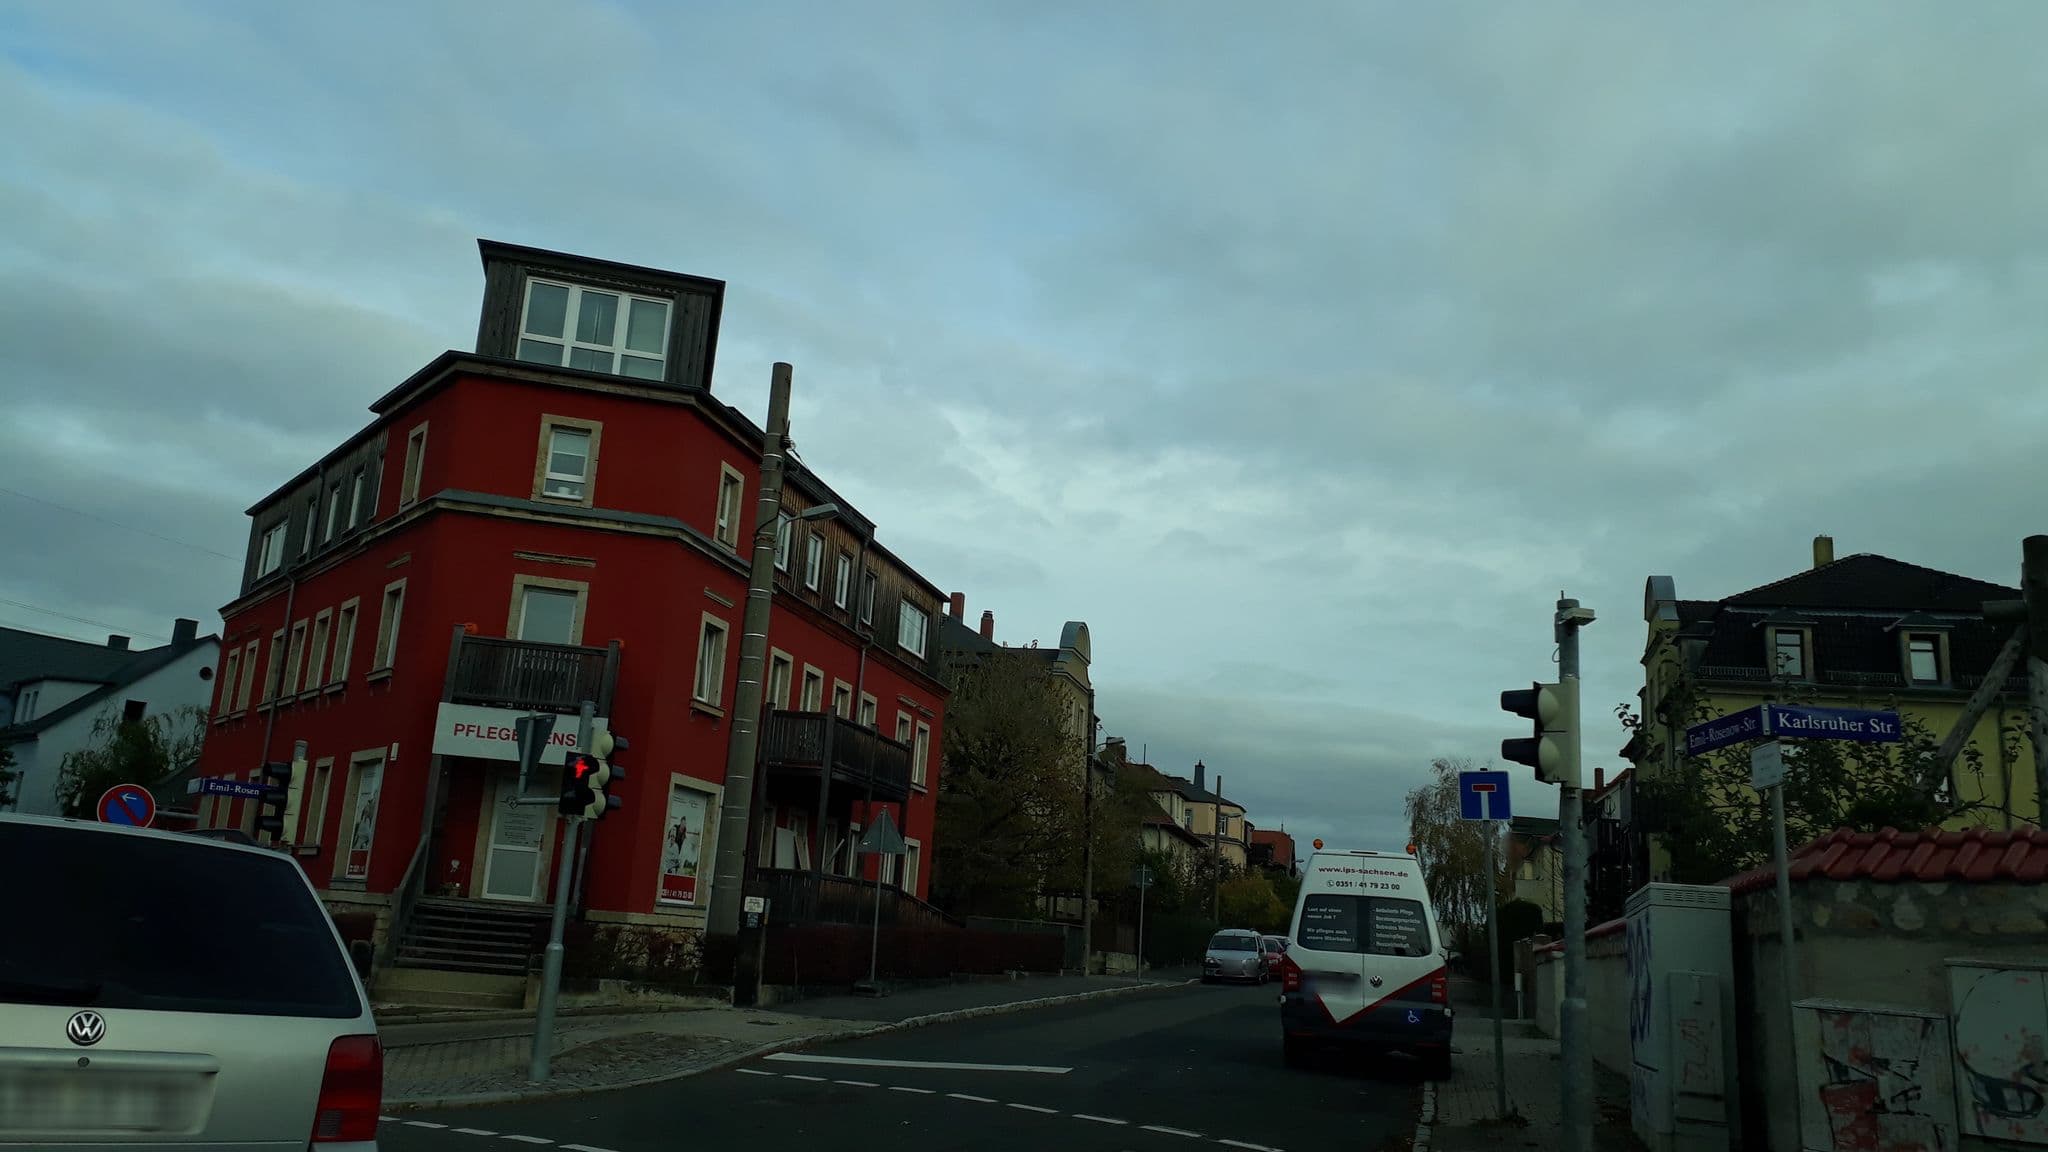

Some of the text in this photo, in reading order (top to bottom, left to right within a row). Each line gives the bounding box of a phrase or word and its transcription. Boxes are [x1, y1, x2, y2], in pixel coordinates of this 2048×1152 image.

[1777, 711, 1897, 734] Karlsruher Str.
[1335, 880, 1353, 888] 0351
[1380, 882, 1390, 890] 23
[1391, 883, 1401, 891] 00
